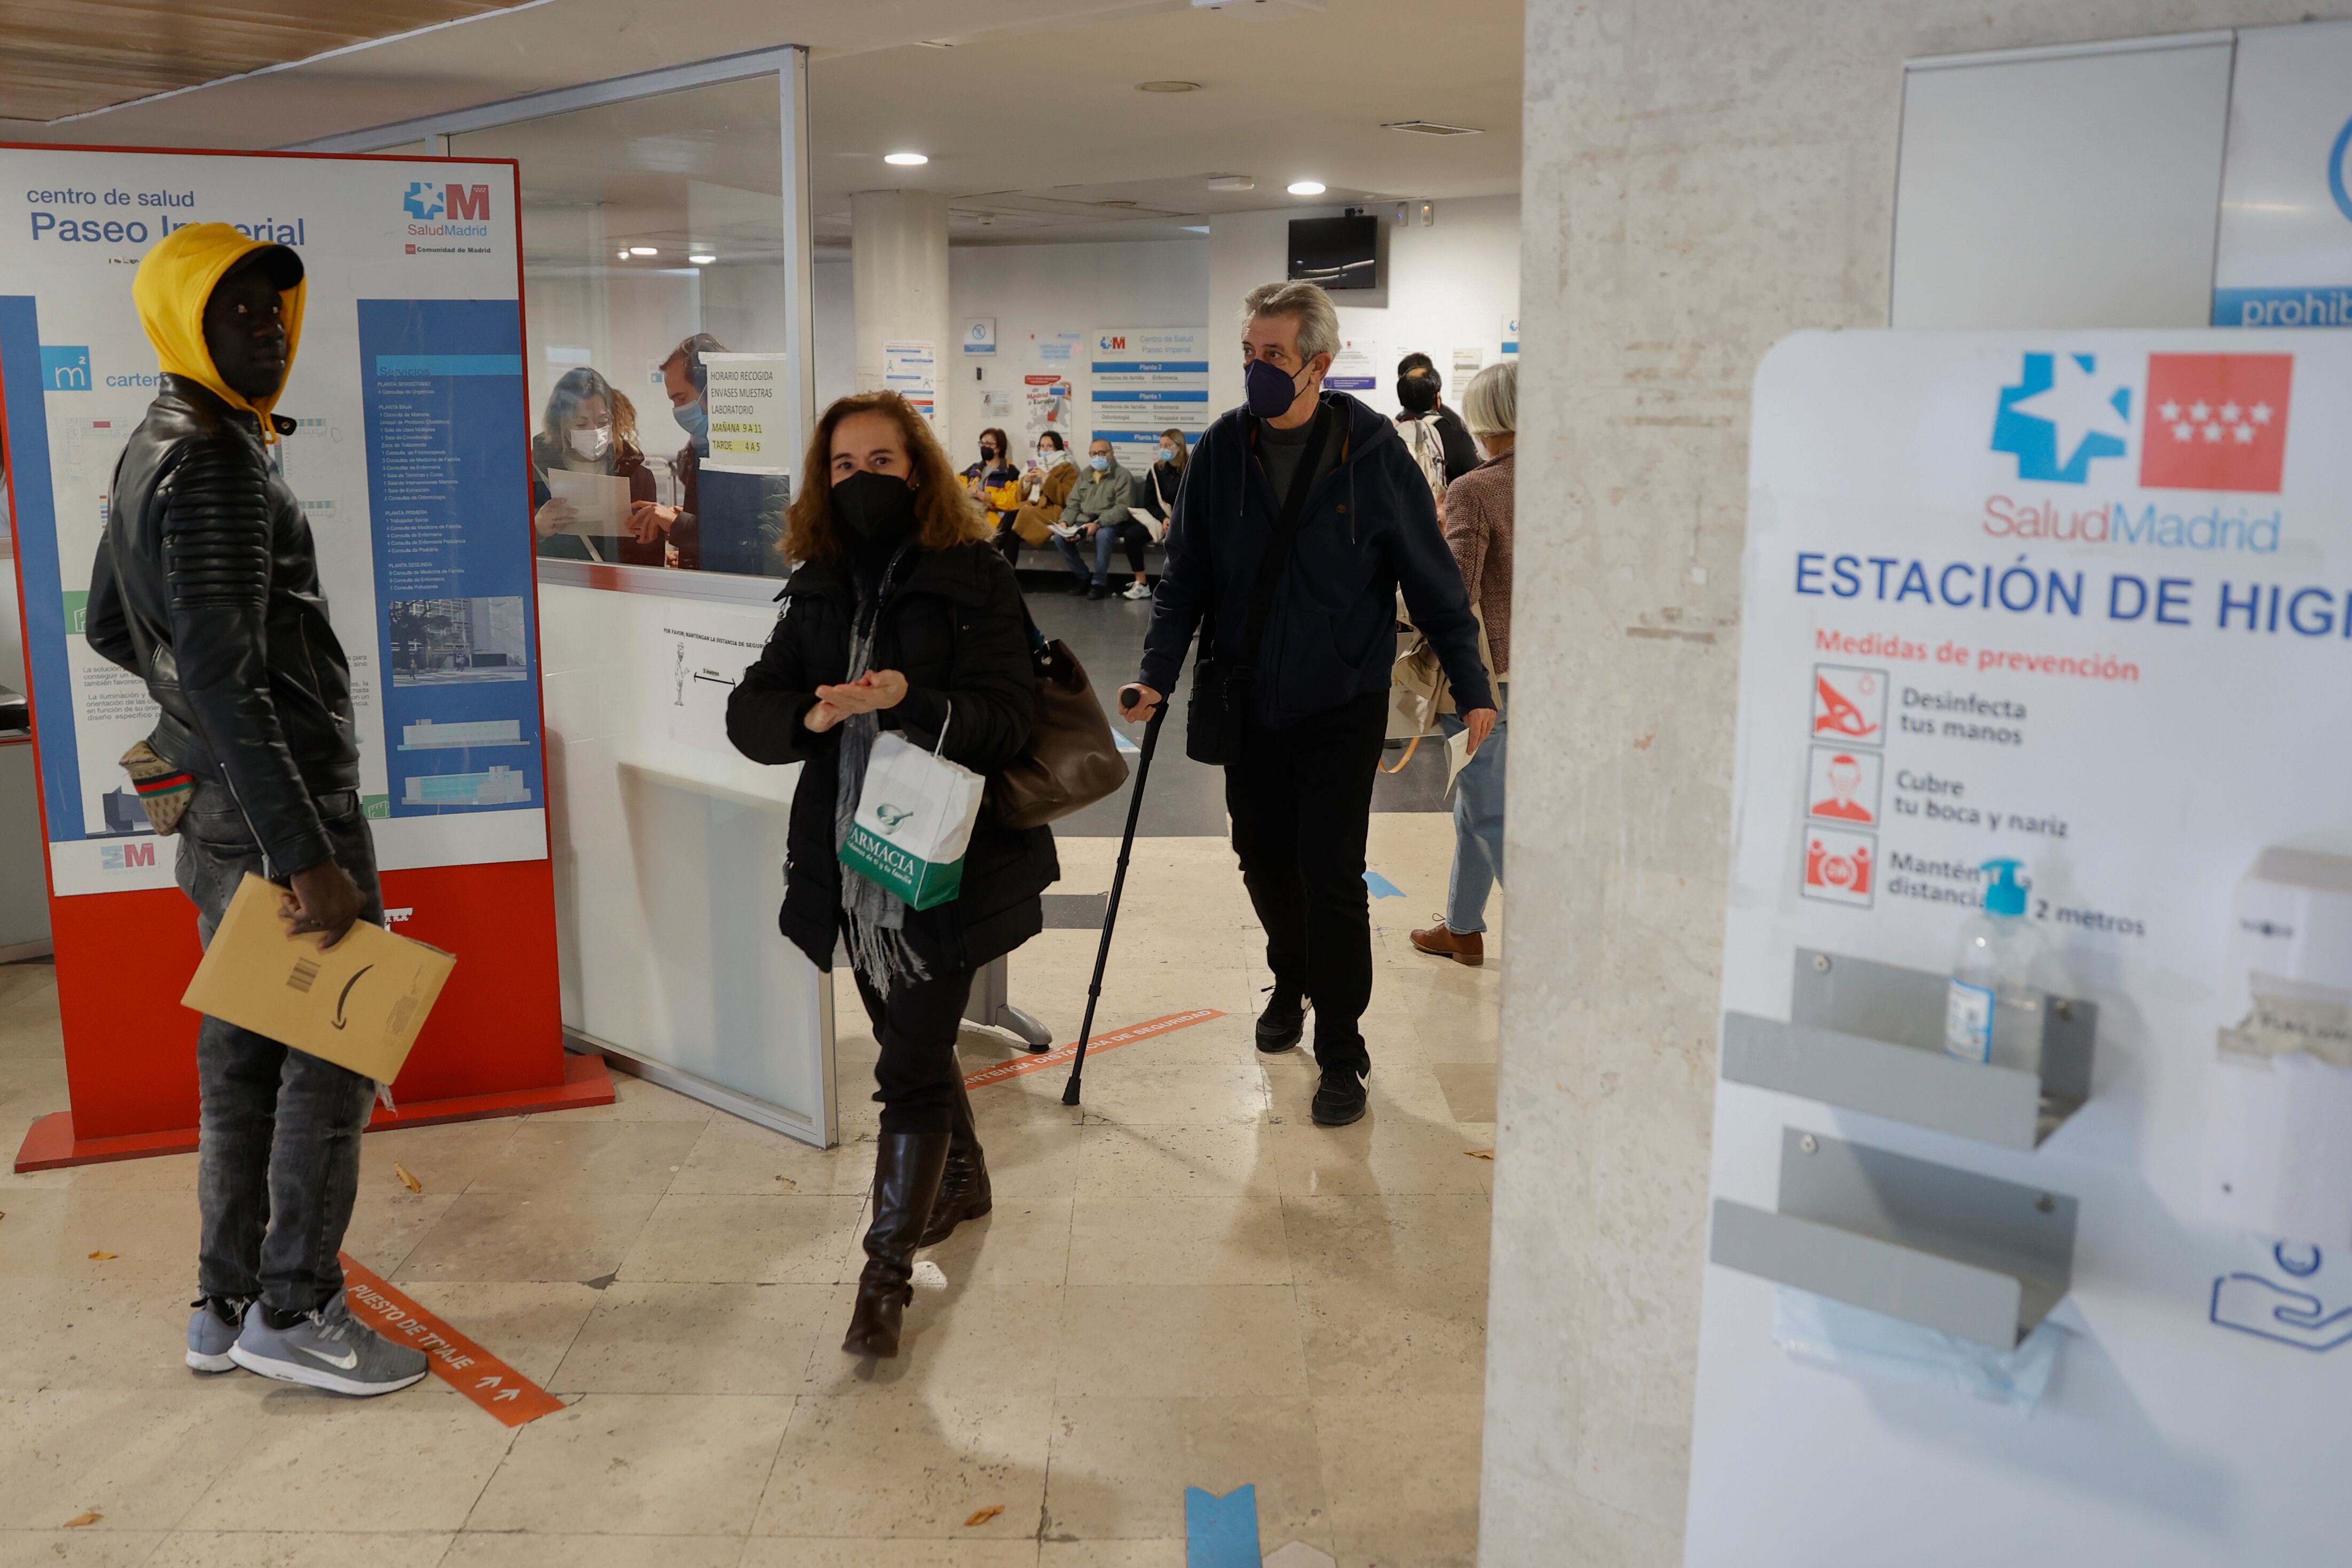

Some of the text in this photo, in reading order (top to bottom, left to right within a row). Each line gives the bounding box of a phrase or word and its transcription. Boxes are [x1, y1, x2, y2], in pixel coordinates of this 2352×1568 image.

[27, 188, 194, 207] centro de salud
[30, 212, 304, 246] Paseo Ierial
[408, 224, 487, 236] SaludMadrid
[1165, 346, 1191, 354] Imperial
[380, 367, 429, 376] Servicios
[711, 372, 773, 380] HORARIO RECOGIDA
[711, 388, 772, 397] ENVASES MUESTRAS
[712, 405, 753, 414] LABORATORIO
[712, 421, 762, 433] MAÑANA 9 A 11
[712, 440, 760, 451] TARDE 4 A 5
[1982, 493, 2281, 554] SaludMadrid
[1795, 553, 2352, 641] ESTACIÓN DE HIG
[686, 632, 709, 641] MANTENGAN
[716, 638, 737, 646] DISTANCIA
[1816, 629, 2139, 682] Medidas de prevención
[1902, 687, 2028, 720] Desinfecta
[1900, 714, 2022, 745] tus manos
[1896, 769, 1964, 797] Cubre
[1894, 797, 2068, 840] tu boca y nariz
[849, 827, 914, 876] ARMACIA
[892, 868, 912, 885] familia
[1890, 851, 1981, 882] Mantén
[1887, 877, 1985, 908] distanci
[2035, 899, 2049, 920] 2
[2056, 906, 2146, 936] metros
[964, 1010, 1212, 1085] ANTENGA DISTACIA DE SEGURIDAD
[348, 1284, 406, 1321] PUESTO
[396, 1318, 427, 1336] DE
